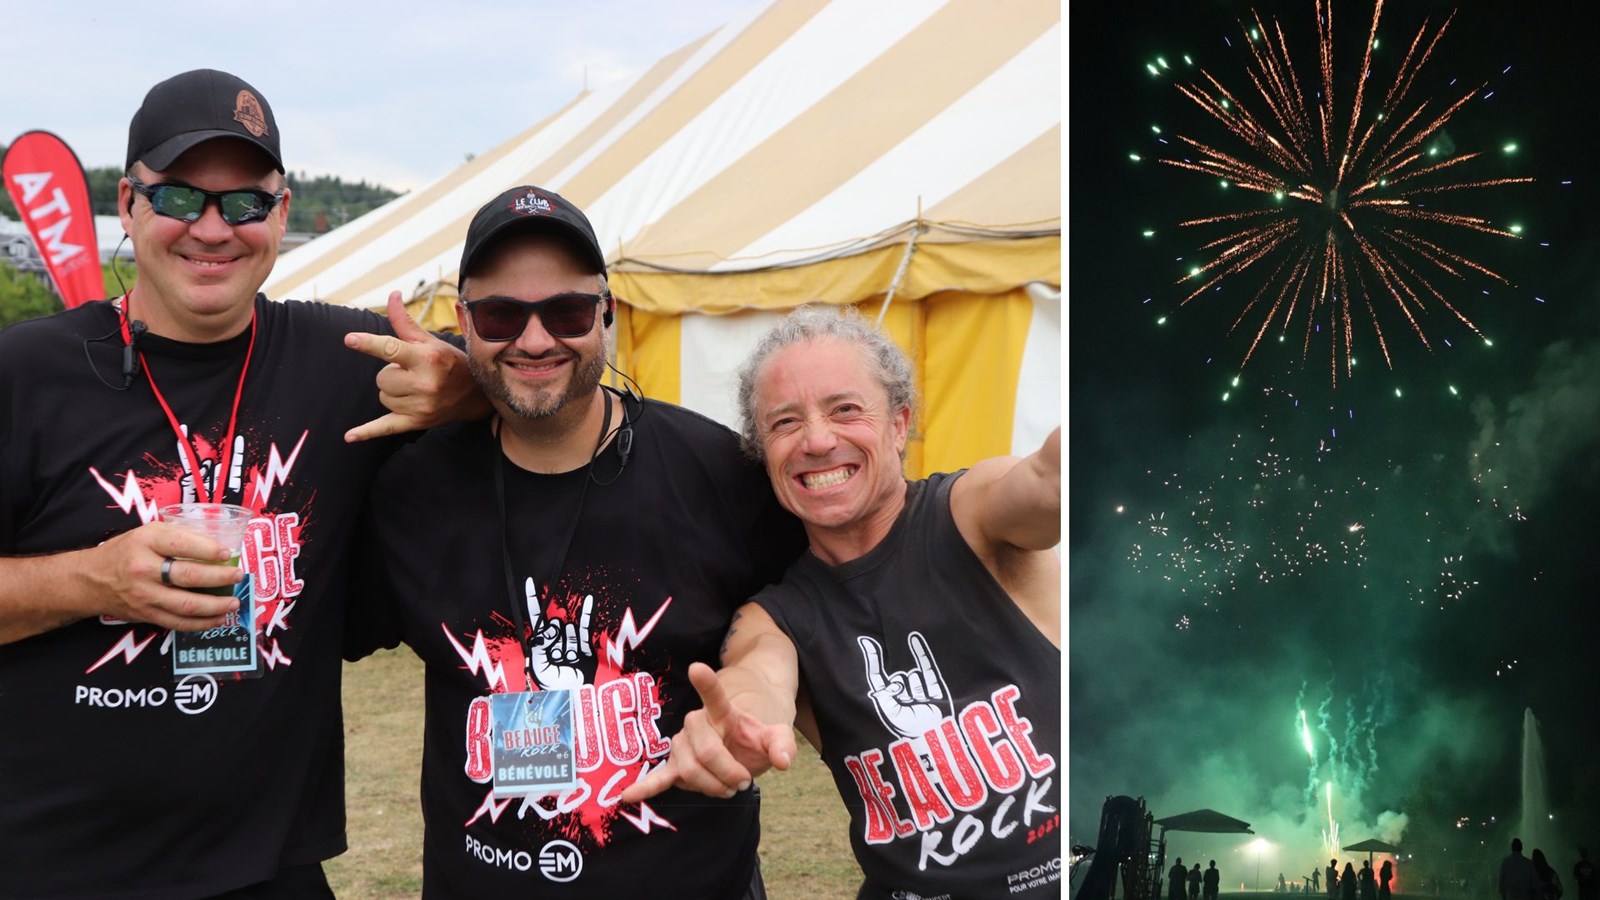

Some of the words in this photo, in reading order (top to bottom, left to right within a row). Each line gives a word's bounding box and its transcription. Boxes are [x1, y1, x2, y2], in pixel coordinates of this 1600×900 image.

[515, 197, 526, 206] LE
[529, 197, 550, 207] CLUB
[12, 171, 84, 266] ATM
[178, 646, 248, 663] BÉNÉVOLE
[75, 685, 168, 708] PROMO
[503, 724, 561, 751] BEAUCE
[520, 744, 560, 757] ROCK
[556, 750, 569, 760] #6
[844, 684, 1056, 845] BEAUCE
[498, 764, 569, 782] BÉNÉVOLE
[918, 776, 1057, 871] ROCK
[1026, 814, 1060, 844] 2021
[466, 834, 532, 871] PROMO
[1007, 857, 1061, 885] PROMO
[1009, 883, 1028, 894] POUR
[1027, 876, 1048, 889] VOTRE
